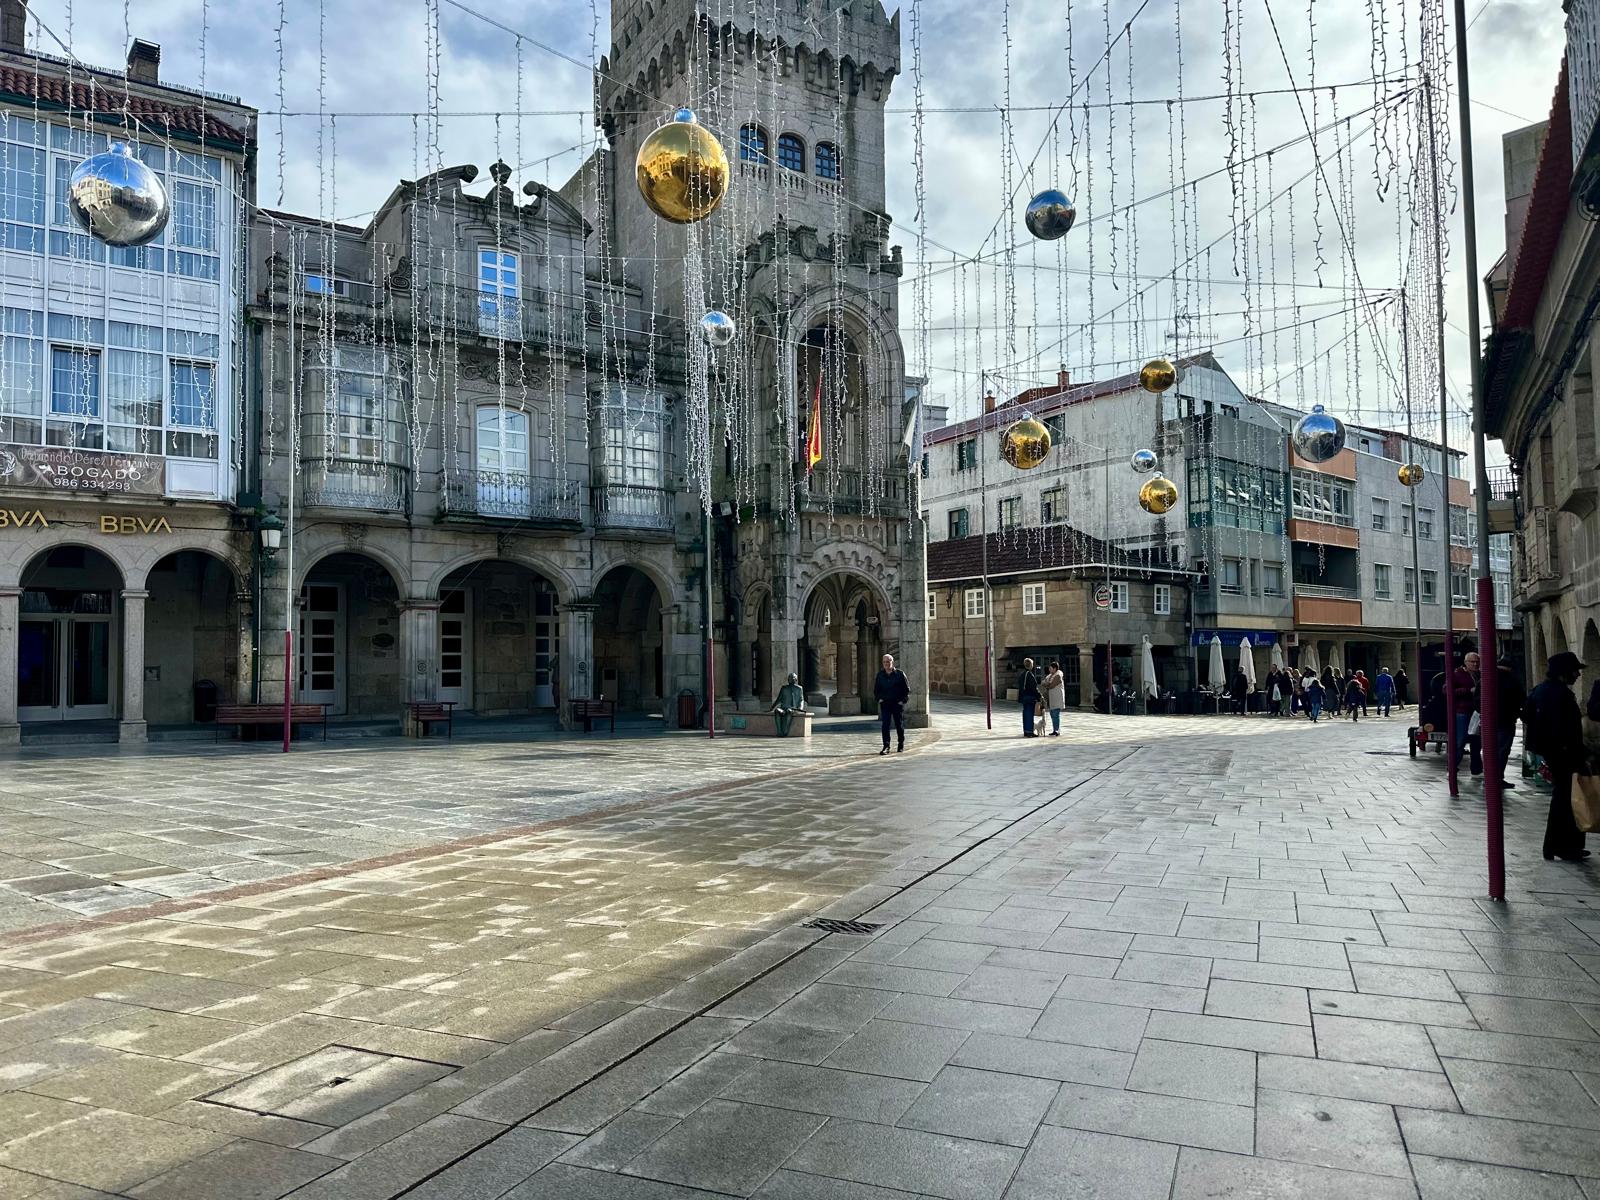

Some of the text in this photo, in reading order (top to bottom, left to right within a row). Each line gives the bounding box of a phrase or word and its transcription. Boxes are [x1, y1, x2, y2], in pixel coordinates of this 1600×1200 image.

[72, 452, 106, 467] Pérez
[43, 464, 141, 481] ABOGADO
[53, 477, 78, 487] 986
[82, 480, 105, 489] 334
[100, 515, 172, 534] BBVA
